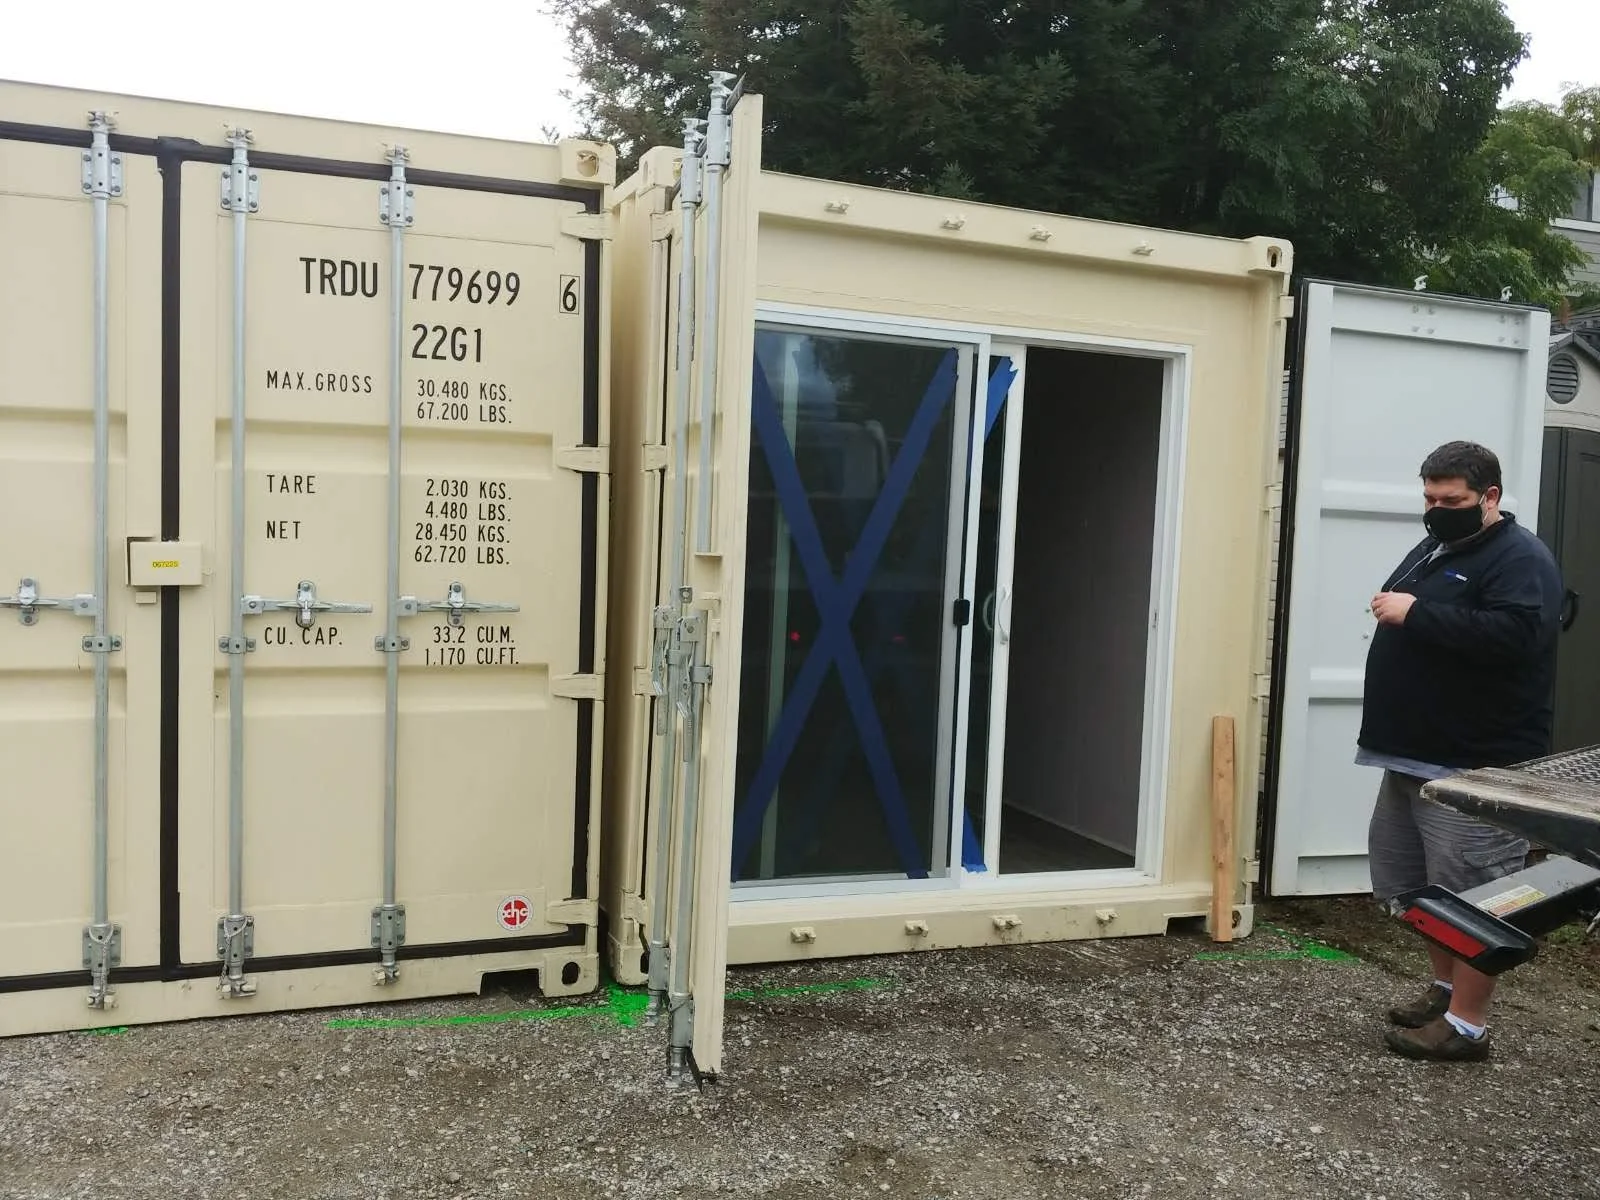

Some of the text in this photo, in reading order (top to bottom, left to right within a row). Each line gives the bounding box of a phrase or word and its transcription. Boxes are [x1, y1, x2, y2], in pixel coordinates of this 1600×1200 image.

[298, 256, 577, 313] TRDU 779699 6
[411, 323, 482, 363] 22G1
[417, 378, 469, 400] 30.480
[479, 382, 512, 403] KGS.
[416, 401, 512, 424] 67.200 LBS.
[266, 474, 512, 501] TARE 2.030 KGS.
[424, 500, 511, 523] 4.480 LBS.
[266, 520, 511, 544] NET 28.450 KGS.
[414, 544, 510, 566] 62.720 LBS.
[433, 625, 466, 644] 33.2
[424, 647, 466, 666] 1.170
